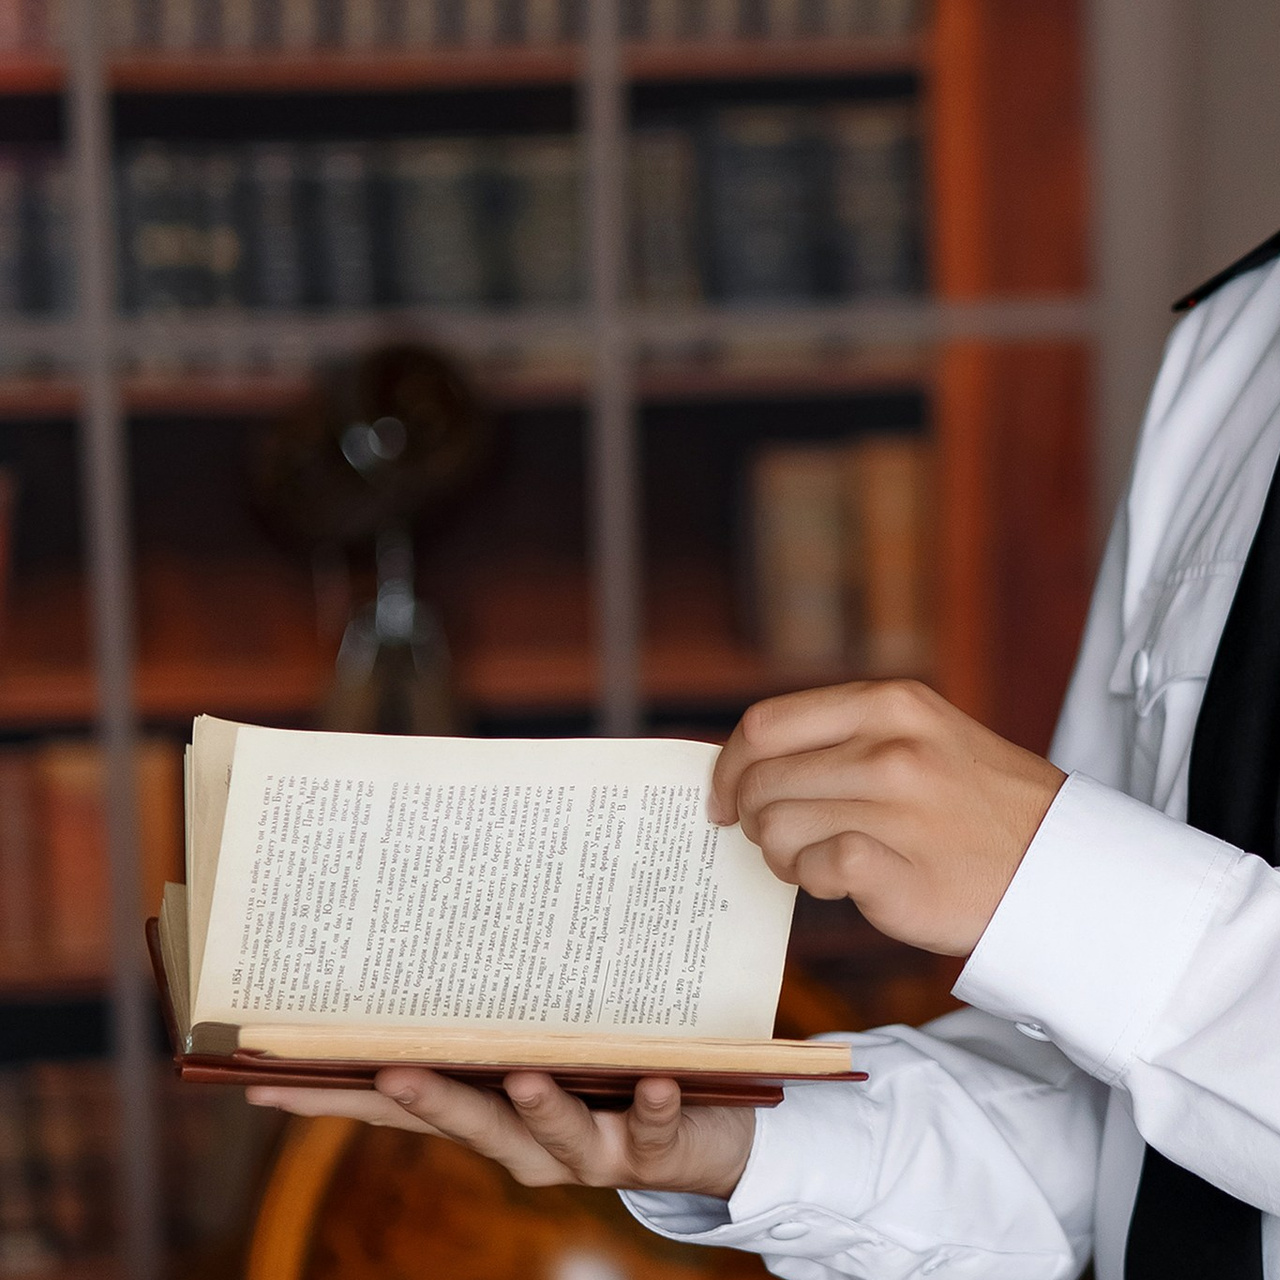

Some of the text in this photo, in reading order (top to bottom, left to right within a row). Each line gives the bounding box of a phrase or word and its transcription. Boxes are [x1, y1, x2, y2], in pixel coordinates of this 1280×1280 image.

[270, 806, 280, 834] залива
[303, 809, 314, 827] При
[381, 782, 399, 844] Корсаковского
[516, 786, 532, 852] представляется
[555, 786, 565, 815] колена
[264, 838, 277, 866] берегу
[300, 904, 310, 919] 300
[311, 830, 323, 865] которые
[317, 796, 327, 827] сильно
[305, 927, 318, 955] Целью
[313, 880, 326, 922] основания
[329, 779, 342, 822] упрочение
[376, 848, 388, 884] западнее
[423, 846, 434, 878] катятся
[512, 857, 522, 877] море
[546, 831, 558, 859] бредет
[245, 897, 255, 921] слухи
[256, 795, 293, 991] Двенадцатифутовой называется
[257, 899, 267, 908] 12
[264, 977, 276, 1011] глубокое
[276, 893, 290, 943] соединенное
[286, 851, 296, 876] морем
[299, 776, 307, 796] куда
[291, 857, 307, 917] мелкосидящие
[319, 780, 364, 1013] трактата 1875 упразднен ненадобностью
[332, 965, 346, 1005] покинутые
[355, 831, 367, 871] сожжены
[361, 804, 372, 826] были
[374, 802, 407, 967] веселая дорога самого направо
[414, 785, 455, 988] бордюром побережью морская
[427, 928, 443, 980] выброшенная
[443, 866, 453, 884] Она
[449, 832, 459, 860] издает
[454, 785, 466, 826] приторно
[444, 904, 458, 947] противный
[457, 835, 469, 873] гниющей
[471, 968, 479, 980] всё
[495, 786, 510, 829] Пароходы
[507, 882, 518, 911] потому
[508, 928, 520, 959] изредка
[520, 854, 532, 898] покажется
[527, 802, 540, 850] неуклюжая
[515, 949, 527, 980] которая
[522, 908, 534, 946] движется
[535, 840, 546, 869] иногда
[540, 861, 553, 909] каторжный
[545, 862, 564, 938] собою веревке
[551, 786, 598, 1009] Вот крутой берег прерывается длинною глубокою
[577, 965, 590, 998] когда-то
[585, 926, 597, 961] казенная
[605, 801, 619, 838] которую
[720, 899, 729, 912] 189
[240, 924, 251, 955] прошли
[255, 913, 264, 935] через
[286, 922, 297, 949] только
[308, 979, 320, 1012] русского
[316, 941, 327, 973] влияния
[324, 881, 337, 915] Южном
[366, 918, 377, 951] которые
[376, 989, 387, 1015] нистые
[382, 947, 395, 985] крутизны
[396, 858, 410, 901] кучерявые
[453, 978, 466, 1017] минутный
[471, 888, 483, 921] морских
[482, 821, 494, 856] которые
[476, 841, 512, 1011] парусные редкие ничего
[567, 967, 578, 981] Тут
[578, 916, 588, 939] речка
[233, 968, 243, 985] 1854
[242, 963, 256, 1009] возобновлен
[280, 954, 291, 985] входить
[391, 961, 403, 995] шумящее
[400, 920, 411, 933] На
[447, 962, 458, 992] южного
[522, 955, 537, 1001] некрасивый
[583, 988, 596, 1023] торжные
[591, 946, 604, 984] называли
[676, 978, 685, 995] 1870
